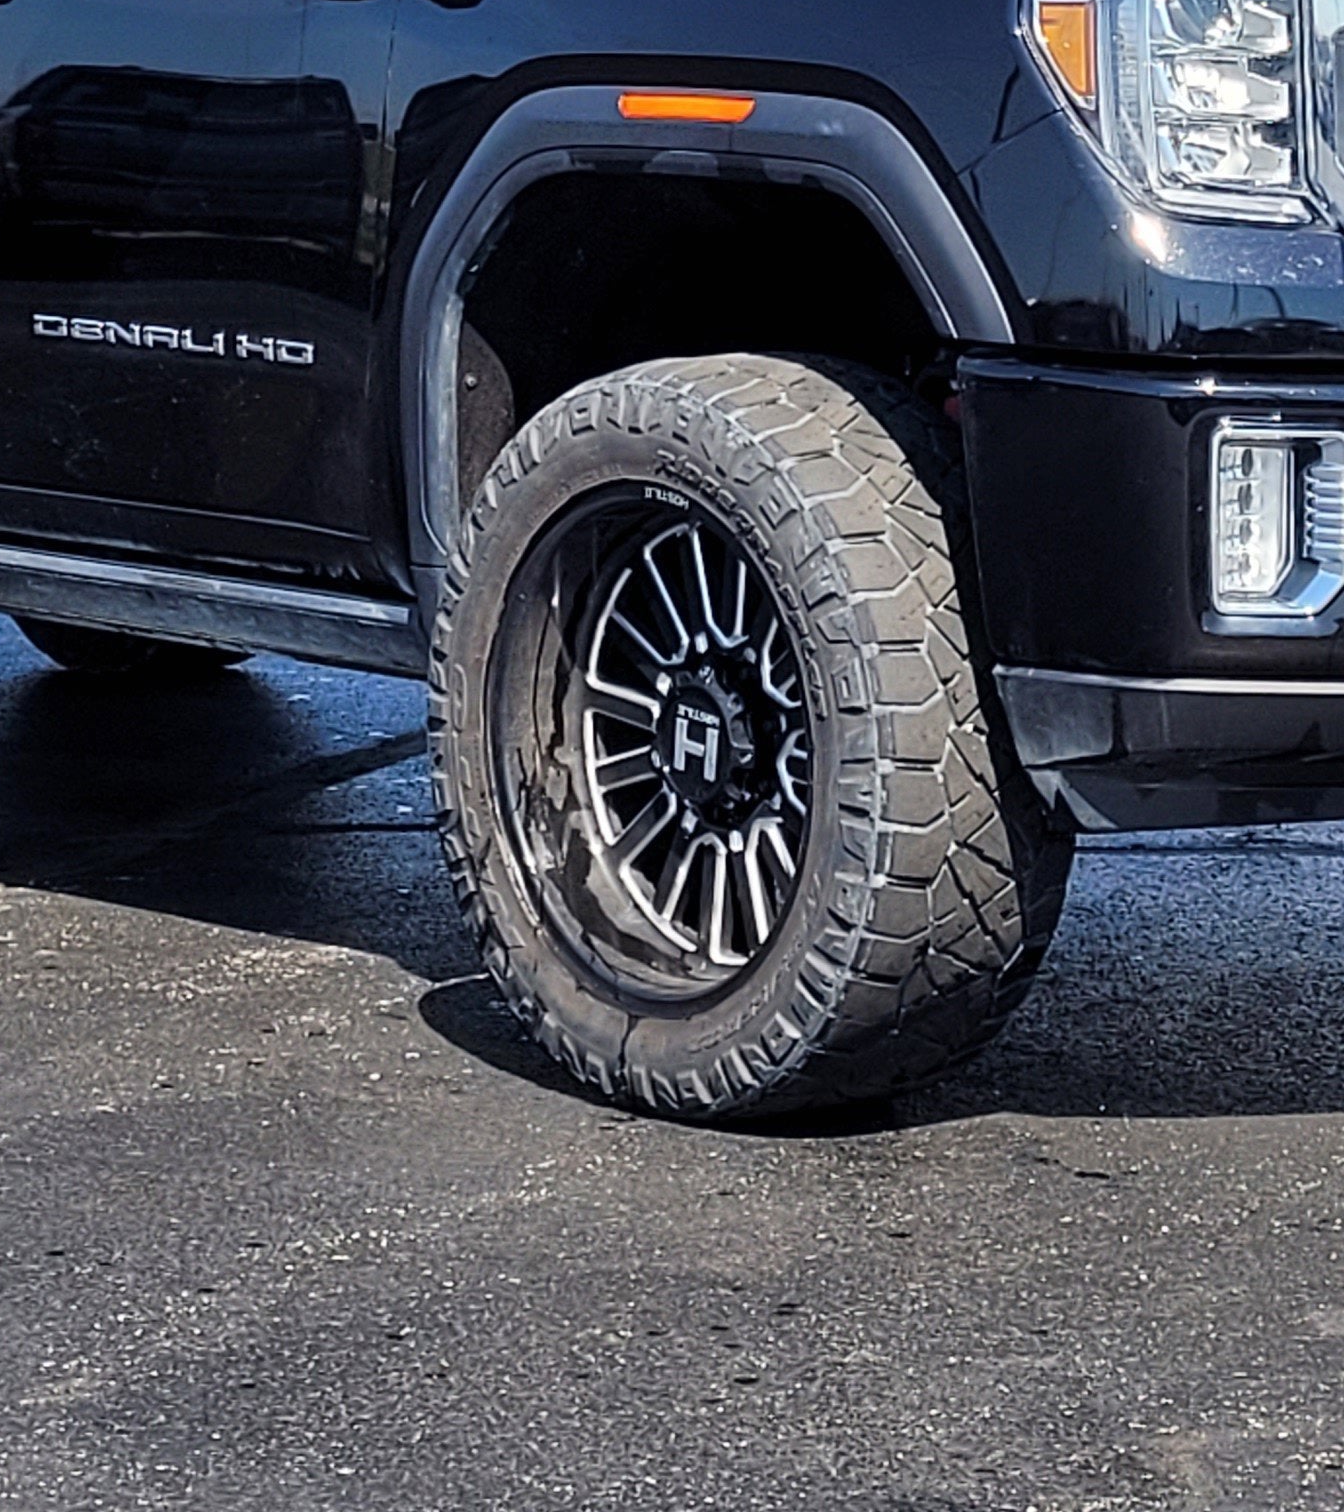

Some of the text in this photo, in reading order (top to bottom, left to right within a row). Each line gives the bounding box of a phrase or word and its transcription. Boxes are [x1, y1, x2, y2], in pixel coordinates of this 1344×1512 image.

[32, 313, 315, 364] DENALI HD
[674, 717, 719, 783] H
